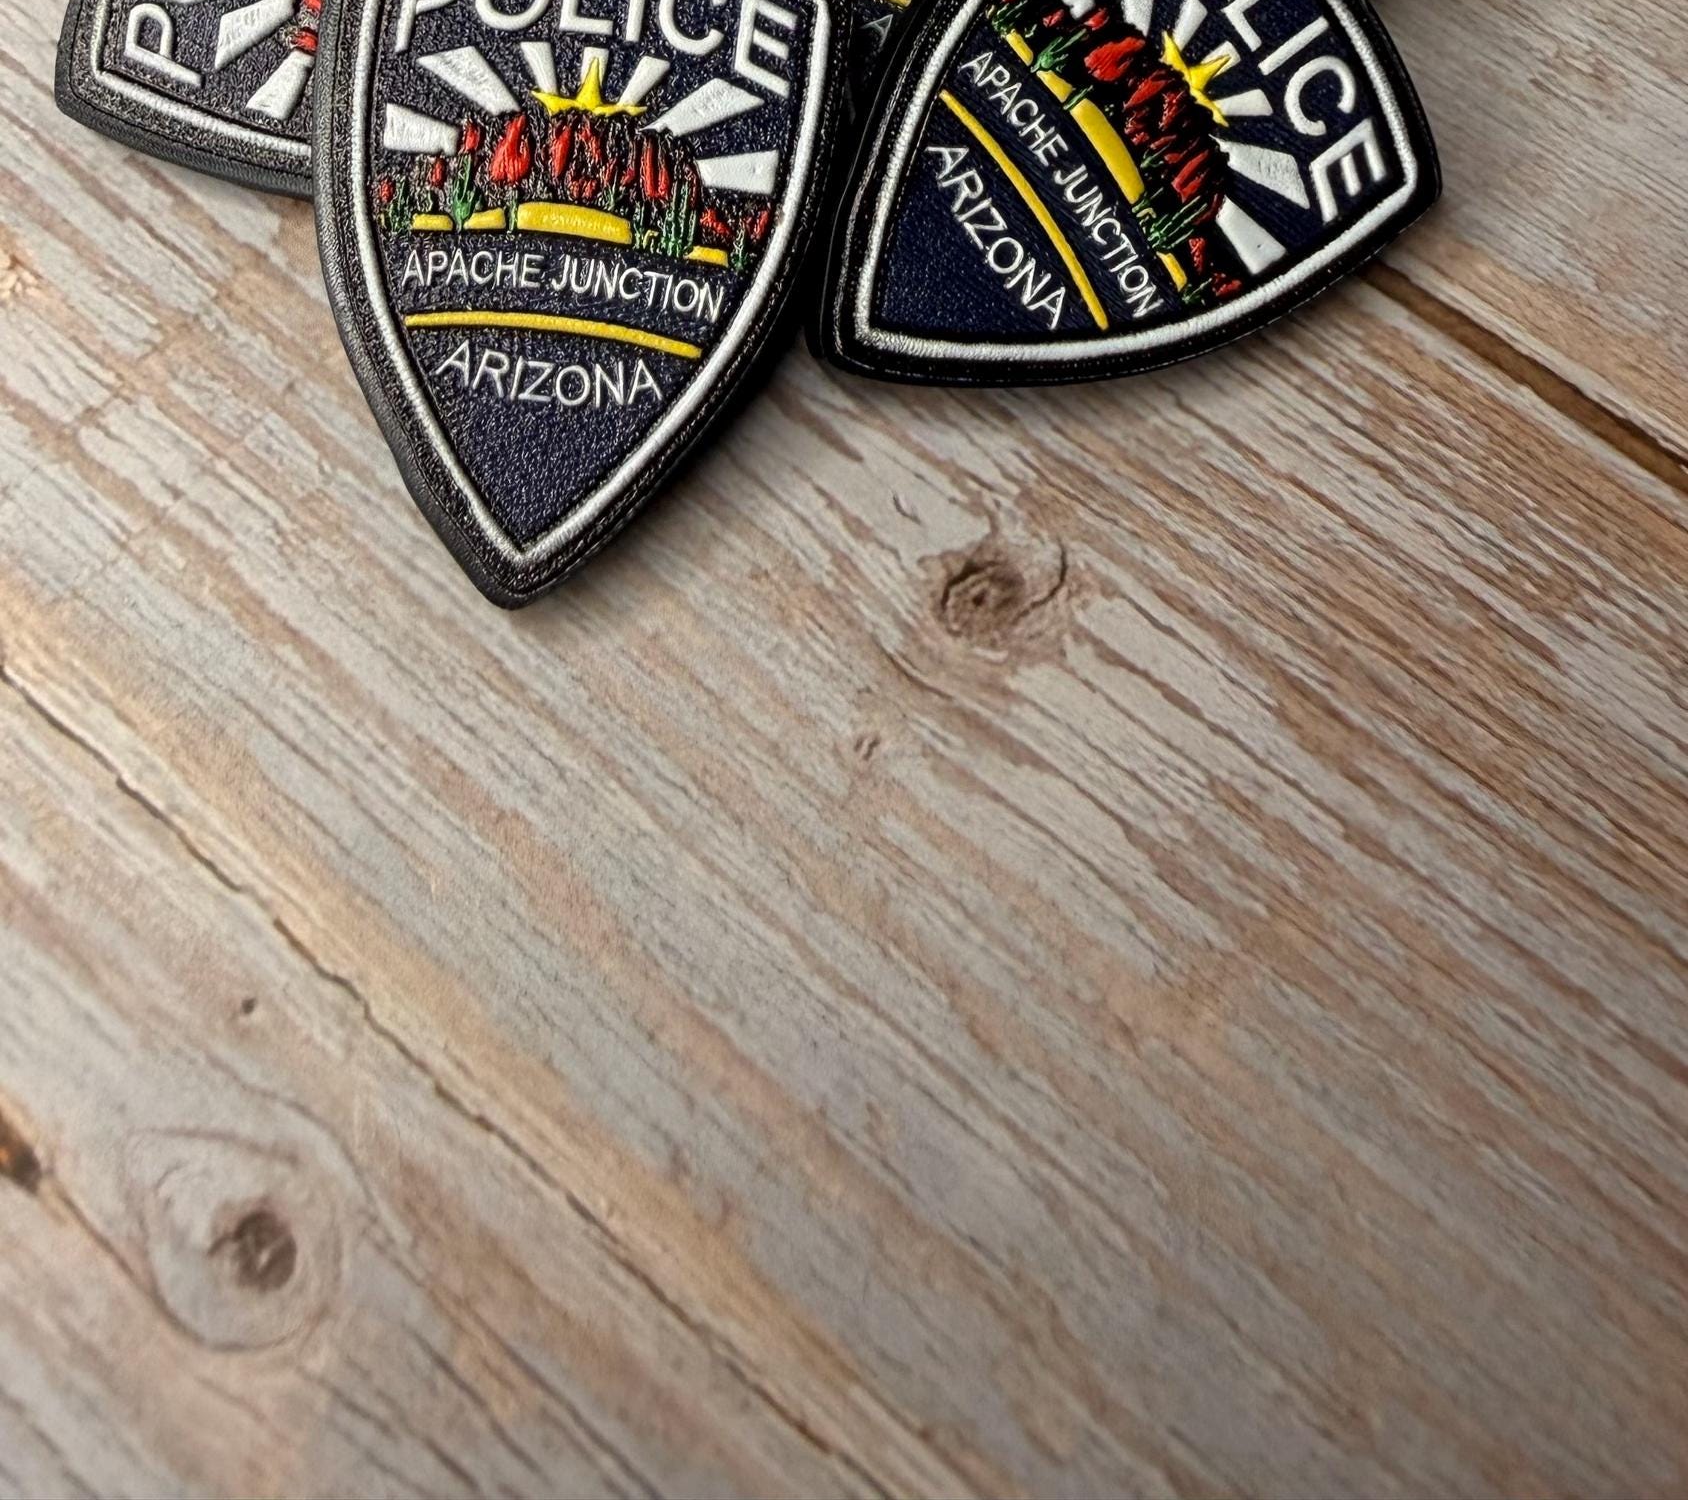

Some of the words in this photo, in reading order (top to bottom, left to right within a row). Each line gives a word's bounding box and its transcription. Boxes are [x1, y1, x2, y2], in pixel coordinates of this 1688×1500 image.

[926, 143, 1070, 332] ARIZONA
[960, 51, 1069, 166] APACHE
[1053, 162, 1165, 320] JUNCTION
[400, 248, 545, 291] APACHE
[551, 256, 726, 324] JUNCTION
[436, 341, 665, 407] ARIZONA
